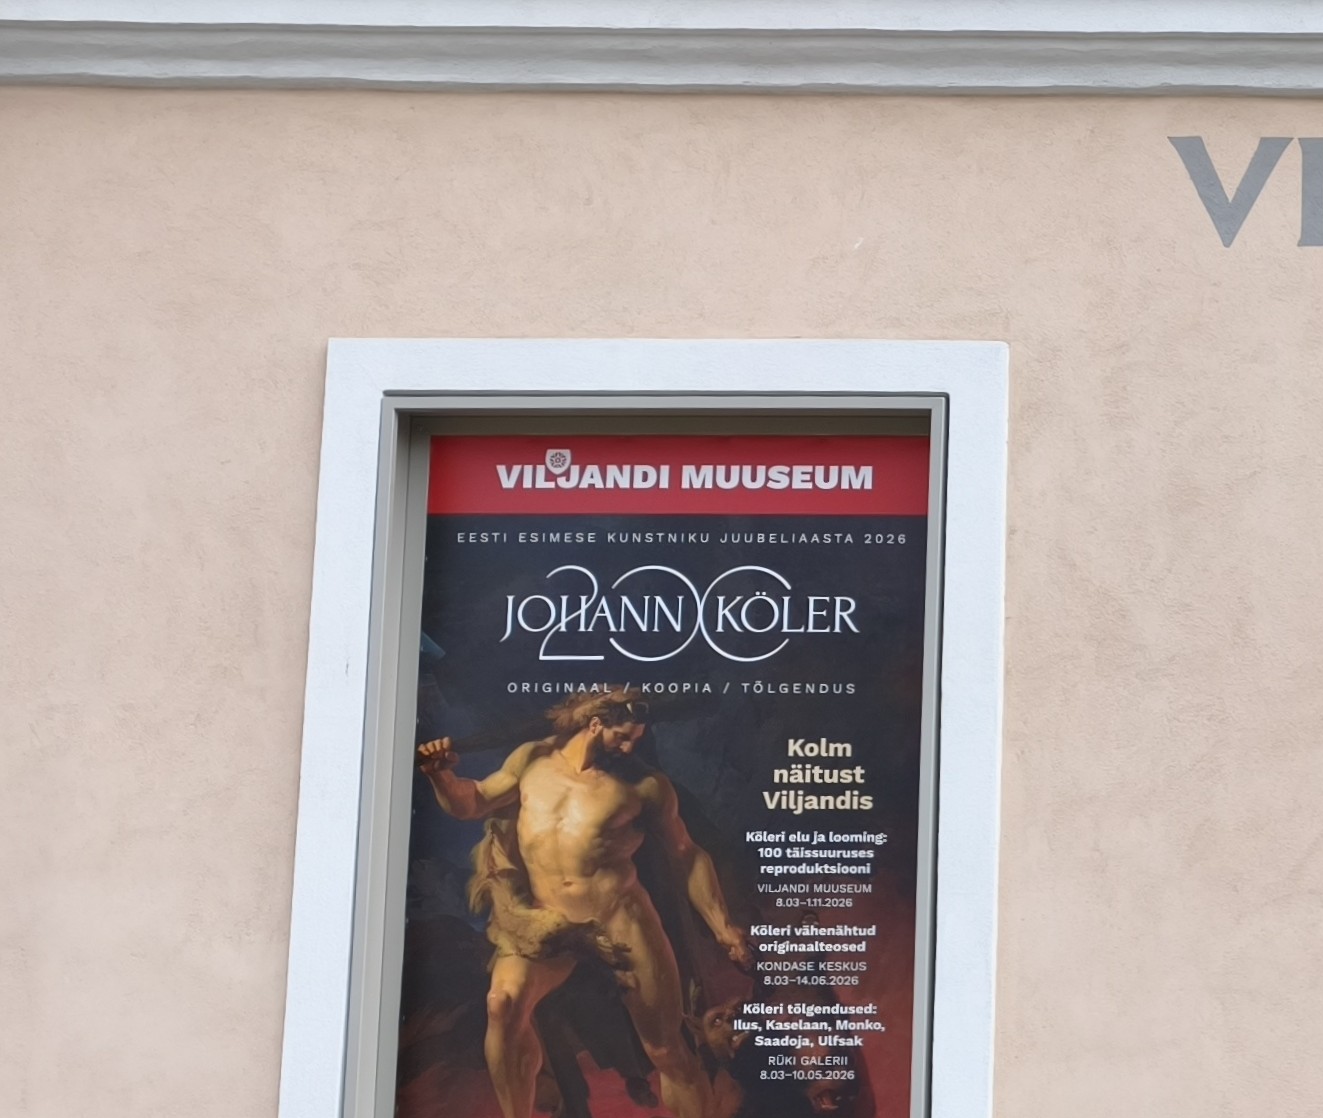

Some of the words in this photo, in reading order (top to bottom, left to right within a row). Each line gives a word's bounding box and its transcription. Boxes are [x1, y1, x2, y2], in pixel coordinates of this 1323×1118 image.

[496, 464, 669, 489] VILJANDI
[681, 464, 872, 490] MUUSEUM
[457, 532, 508, 543] EESTI
[518, 532, 597, 543] ESIMESE
[607, 532, 710, 543] KUNSTNIKU
[720, 533, 854, 544] JUUBELIAASTA
[864, 534, 907, 545] 2026
[500, 595, 682, 642] JOHANN
[716, 590, 860, 634] KÖLER
[507, 682, 612, 694] ORIGINAAL
[642, 682, 712, 694] KOOPIA
[741, 679, 856, 695] TÕLGENDUS
[787, 737, 852, 757] Kolm
[773, 764, 865, 784] näitust
[762, 790, 873, 815] Viljandis
[746, 831, 785, 843] Köleri
[789, 831, 810, 843] elu
[812, 831, 826, 845] ja
[829, 831, 888, 845] looming:
[758, 848, 782, 858] 100
[785, 847, 874, 859] täissuuruses
[760, 863, 871, 876] reproduktsiooni
[757, 884, 810, 893] VILJANDI
[813, 884, 872, 893] MUUSEUM
[750, 924, 791, 937] Köleri
[794, 924, 876, 937] vähenähtud
[759, 941, 867, 954] originaalteosed
[757, 962, 815, 971] KONDASE
[819, 962, 867, 971] KESKUS
[743, 1003, 784, 1014] Köleri
[787, 1003, 877, 1017] tõlgendused:
[733, 1019, 762, 1032] Ilus,
[766, 1019, 832, 1032] Kaselaan,
[835, 1019, 886, 1032] Monko,
[754, 1035, 814, 1049] Saadoja,
[818, 1035, 863, 1046] Ulfsak
[801, 1056, 848, 1065] GALERII
